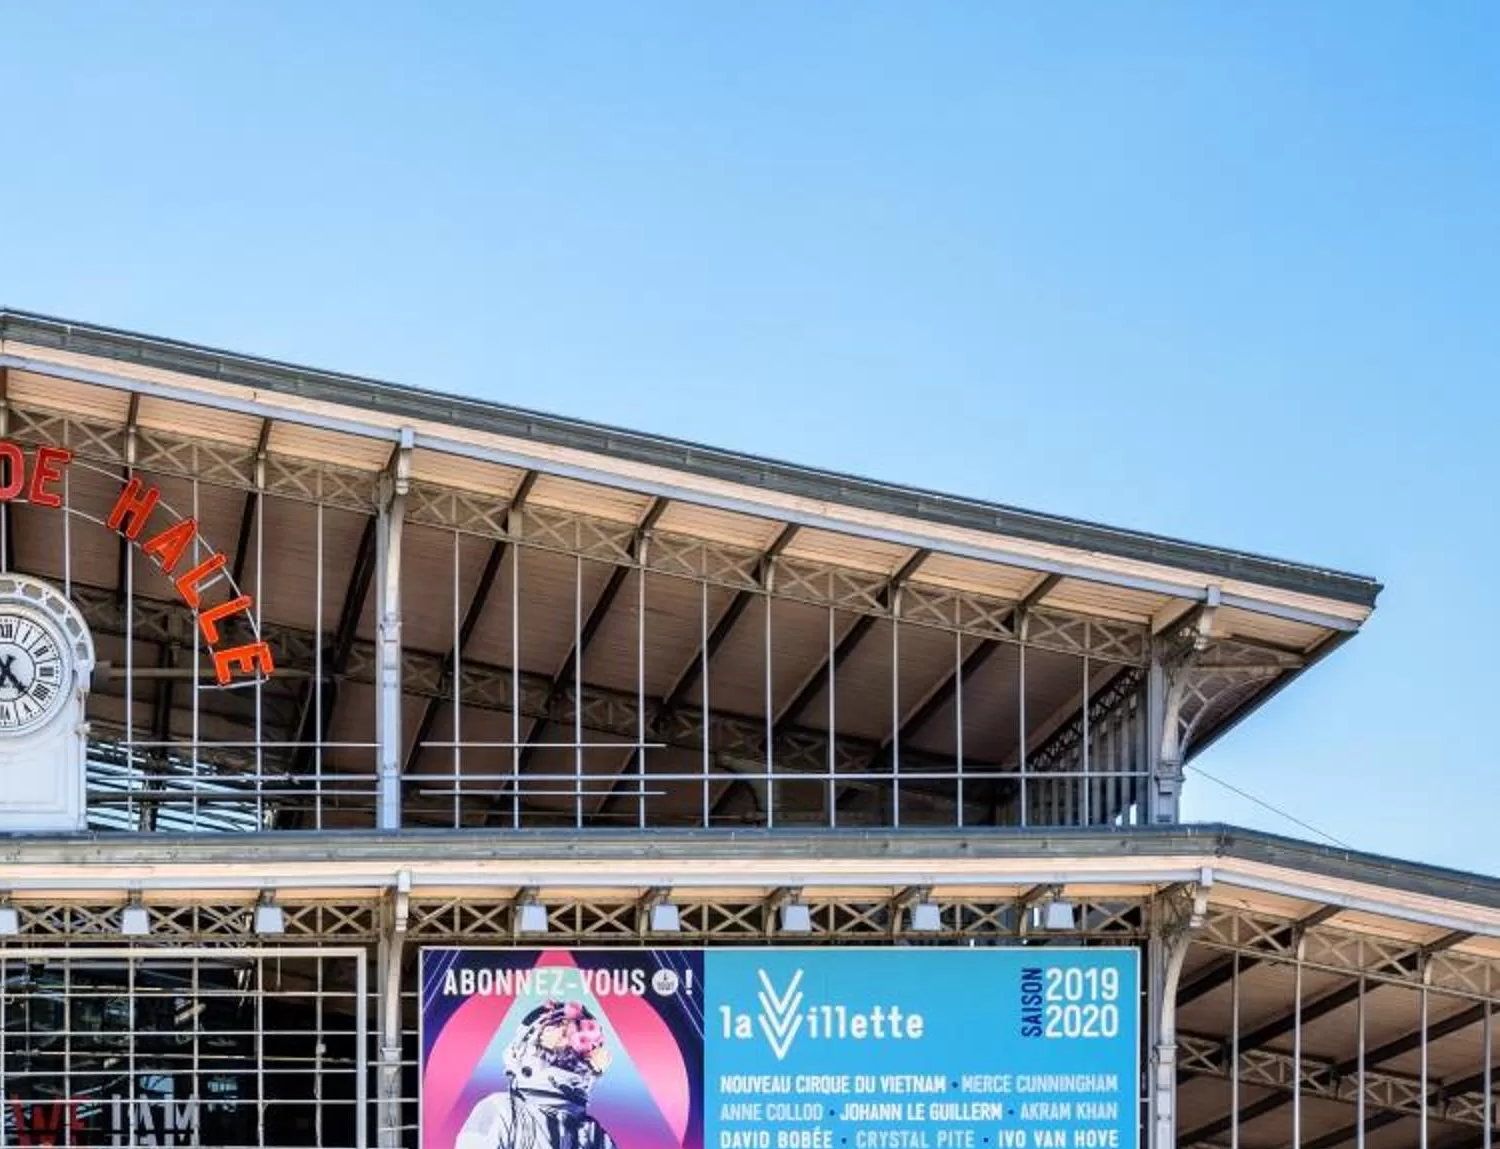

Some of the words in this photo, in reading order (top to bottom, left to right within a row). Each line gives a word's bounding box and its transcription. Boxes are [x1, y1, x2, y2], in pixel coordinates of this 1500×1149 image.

[106, 475, 276, 687] HALLE
[443, 968, 647, 996] ABONNEZ-VOUS
[1044, 967, 1120, 1002] 2019
[1020, 967, 1044, 1038] SAISON
[1044, 1004, 1120, 1039] 2020
[720, 1074, 791, 1094] NOUVEAU
[795, 1074, 851, 1094] CIRQUE
[854, 1074, 876, 1094] DU
[880, 1074, 946, 1094] VIETNAM
[961, 1074, 1013, 1094] MERCE
[1016, 1074, 1119, 1094] CUNNINGHAM
[720, 1103, 762, 1121] ANNE
[766, 1103, 824, 1121] COLLOD
[840, 1103, 902, 1121] JOHANN
[907, 1103, 927, 1121] LE
[929, 1103, 1003, 1121] GUILLERM
[1020, 1103, 1071, 1121] AKRAM
[1076, 1103, 1118, 1121] KHAN
[720, 1130, 771, 1149] DAVID
[777, 1125, 833, 1149] BOBÉE
[855, 1130, 930, 1149] CRYSTAL
[937, 1130, 975, 1149] PITE
[998, 1130, 1026, 1149] IVO
[1033, 1130, 1066, 1149] VAN
[1074, 1130, 1119, 1149] HOVE
